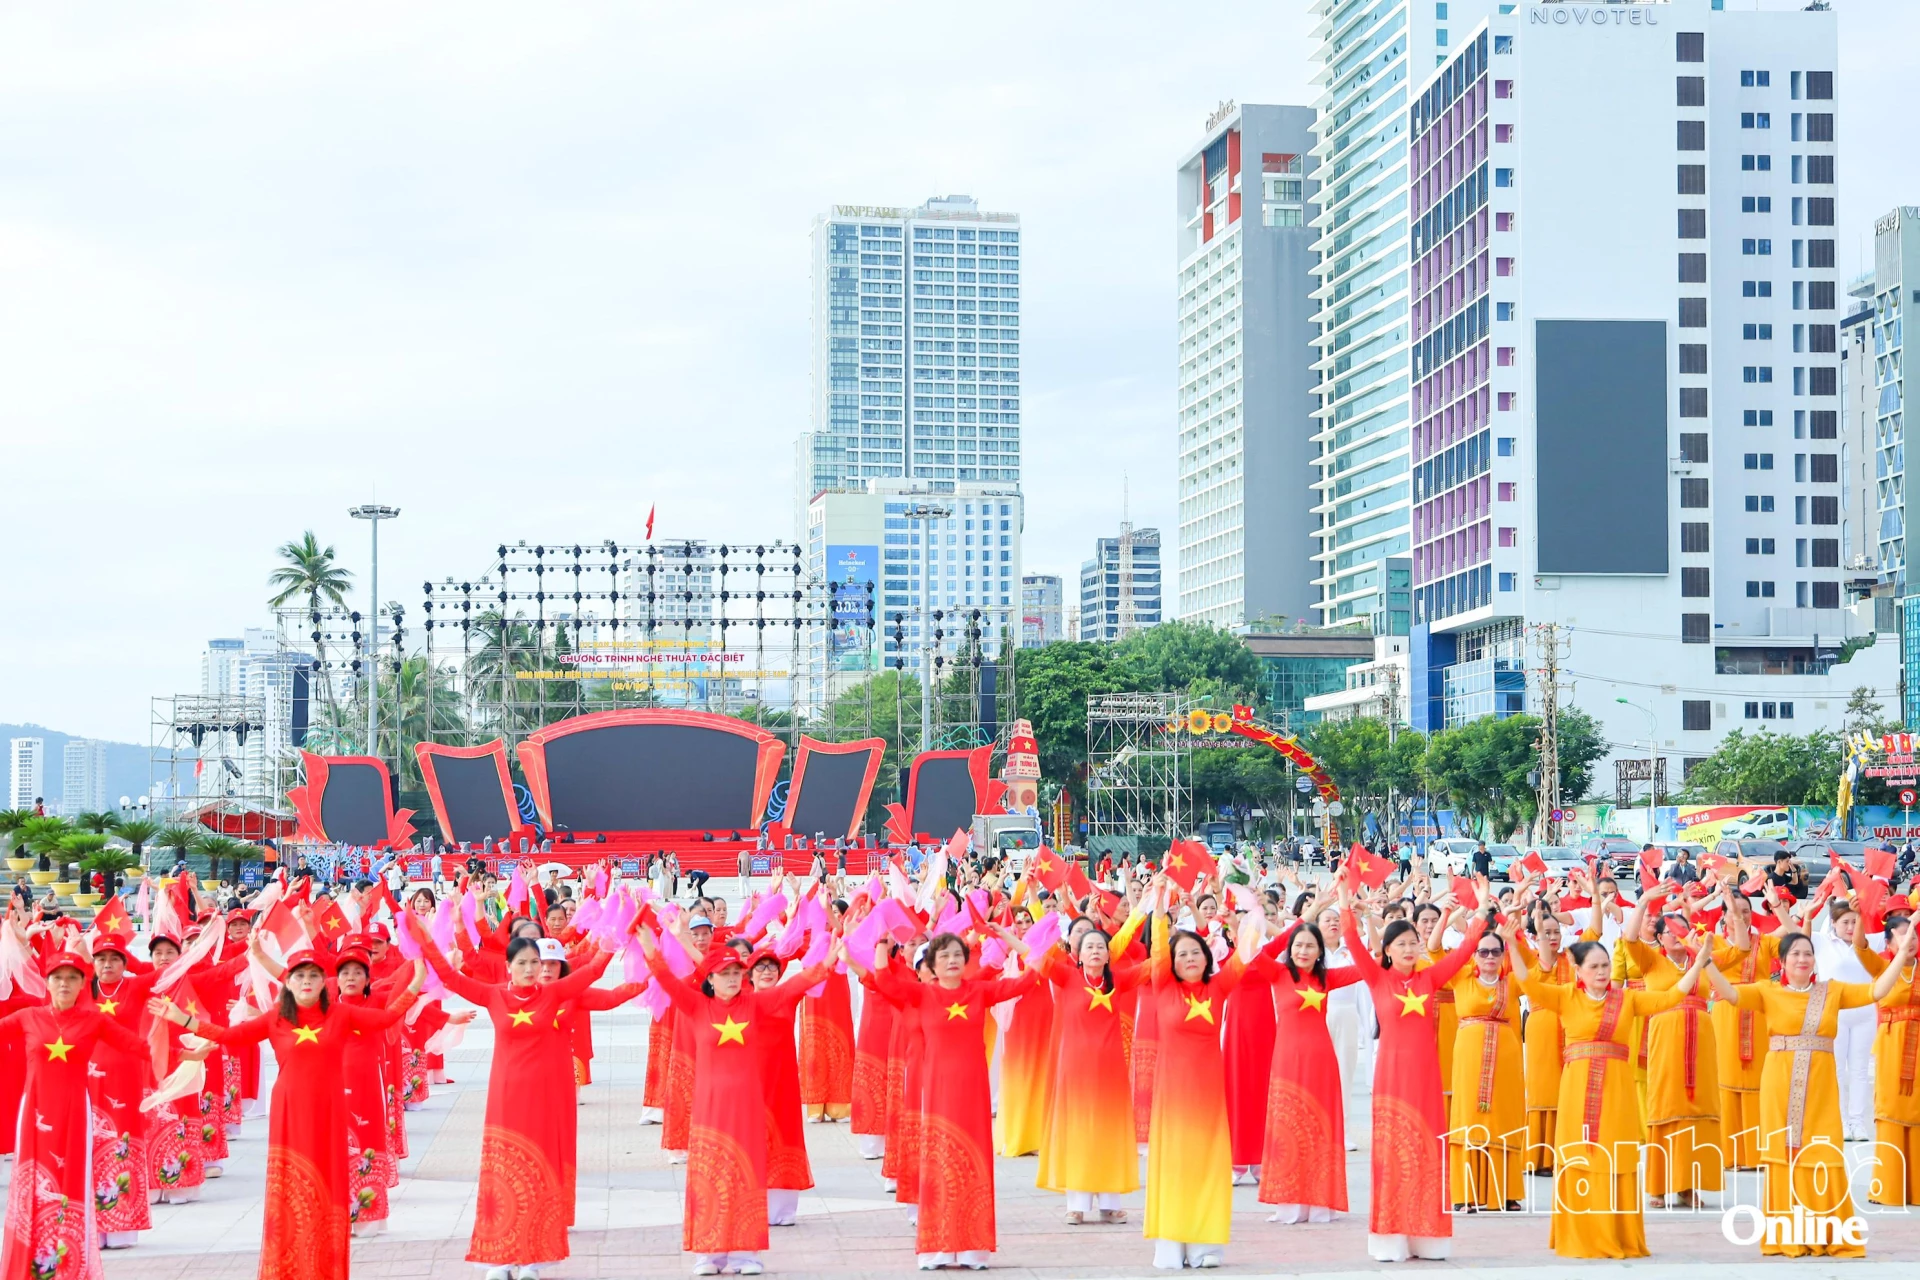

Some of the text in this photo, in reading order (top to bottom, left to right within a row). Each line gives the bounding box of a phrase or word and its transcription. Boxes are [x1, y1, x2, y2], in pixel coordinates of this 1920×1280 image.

[1530, 8, 1658, 25] NOVOTEL
[560, 653, 603, 663] CHƯƠNG
[636, 653, 663, 664] NGHỆ
[666, 653, 698, 664] THUẬT
[723, 652, 745, 664] BIỆT
[1873, 824, 1902, 837] VĂN
